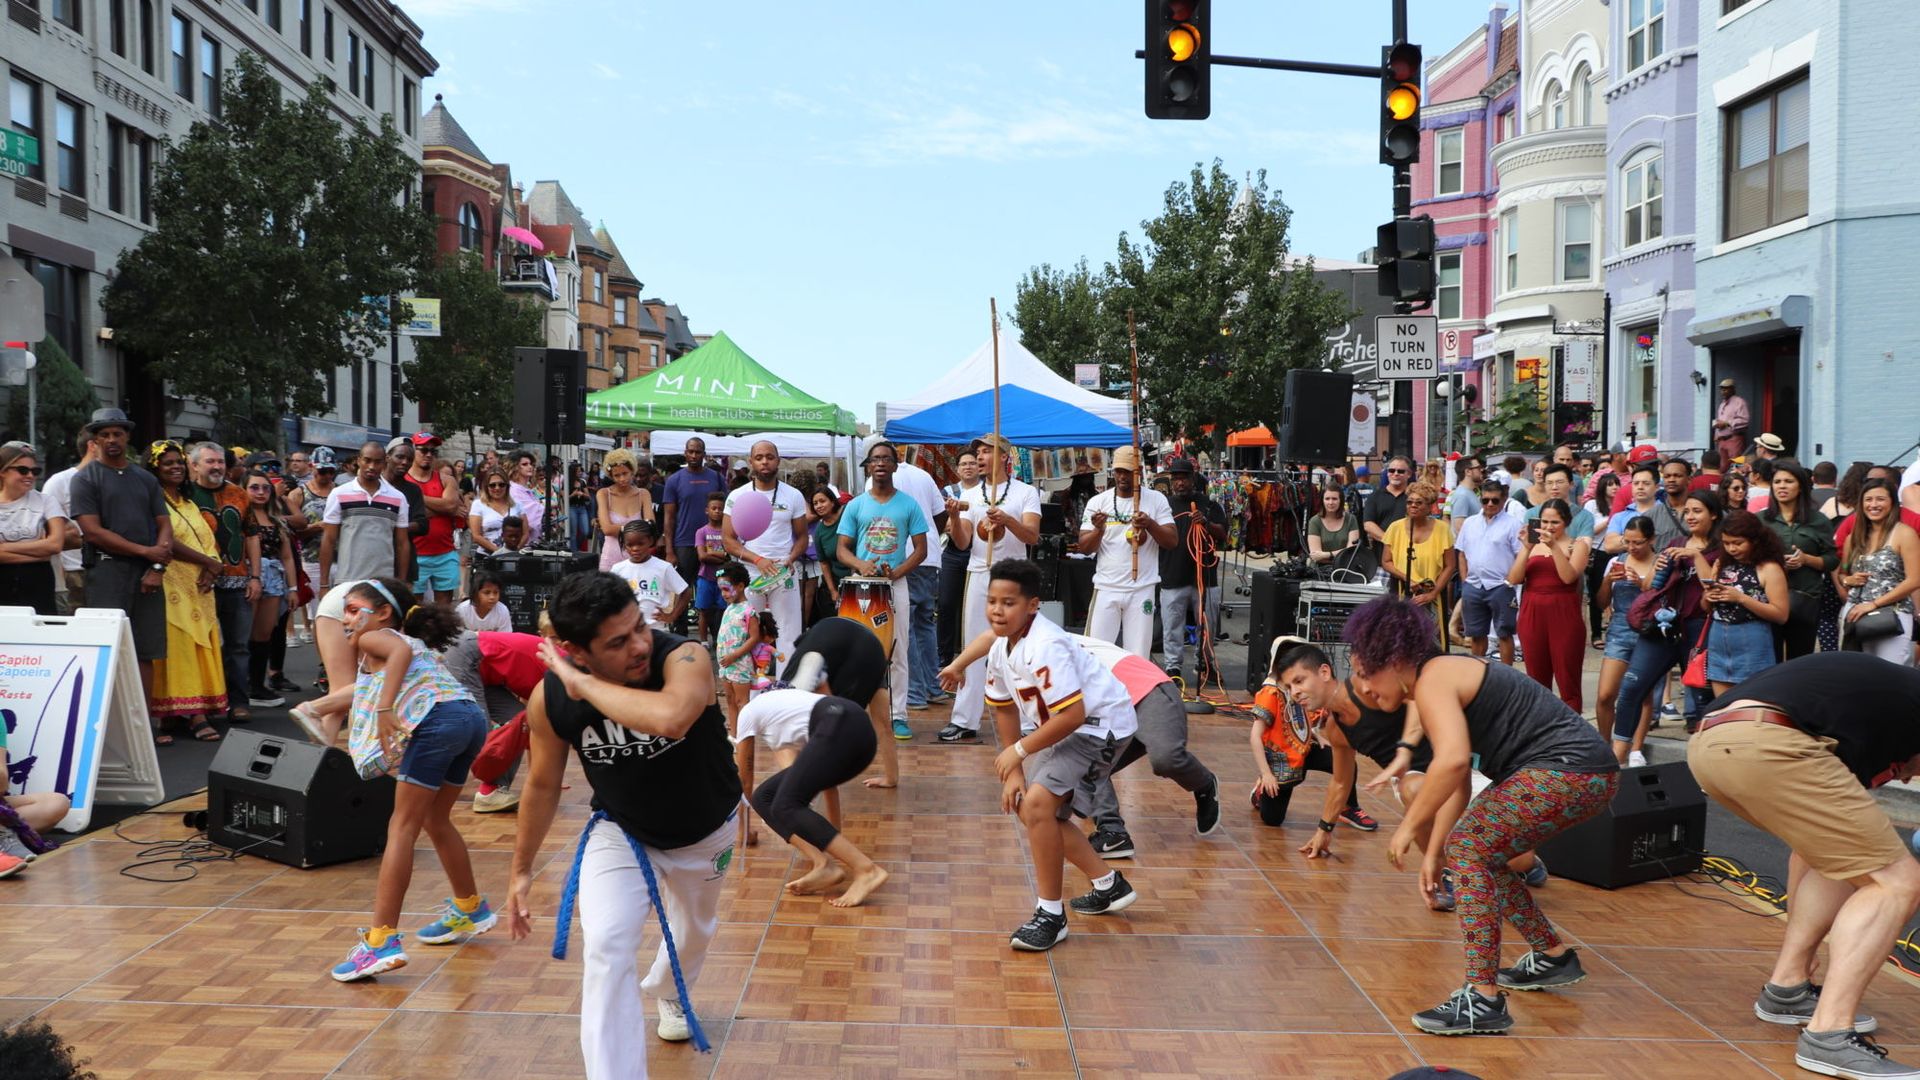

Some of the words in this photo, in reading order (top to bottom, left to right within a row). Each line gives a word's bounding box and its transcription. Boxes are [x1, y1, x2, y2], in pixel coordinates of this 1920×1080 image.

[0, 157, 25, 176] 300
[1396, 324, 1418, 335] NO
[1390, 341, 1425, 353] TURN
[1383, 359, 1401, 370] ON
[1407, 358, 1433, 370] RED
[656, 372, 765, 399] MINT
[670, 406, 713, 419] health
[718, 408, 755, 420] clubs
[772, 408, 823, 420] studios
[0, 654, 42, 666] Capitol
[1034, 665, 1052, 690] 7
[1016, 686, 1050, 728] 7
